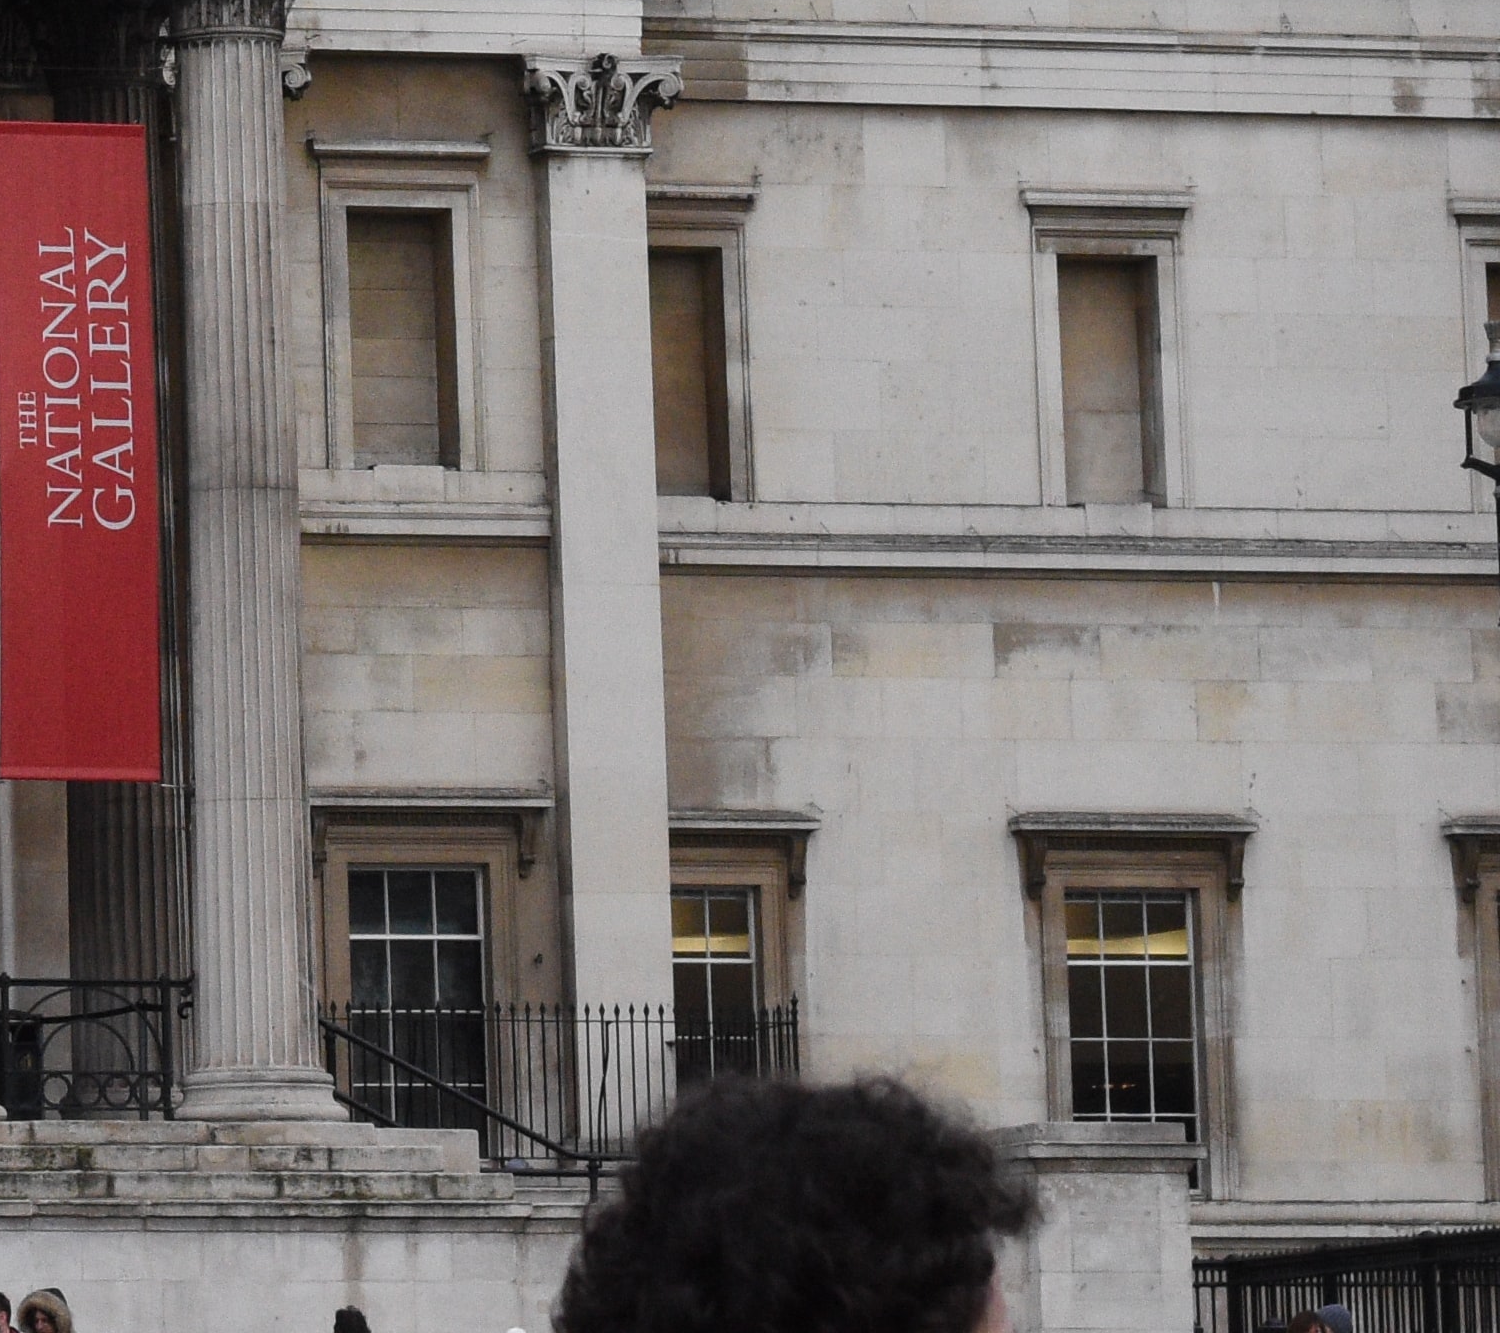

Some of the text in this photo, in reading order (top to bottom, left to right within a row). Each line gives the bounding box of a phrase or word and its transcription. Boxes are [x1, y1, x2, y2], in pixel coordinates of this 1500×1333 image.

[16, 390, 38, 450] THE
[37, 224, 84, 530] NATIONAL
[83, 225, 137, 531] GALLERY
